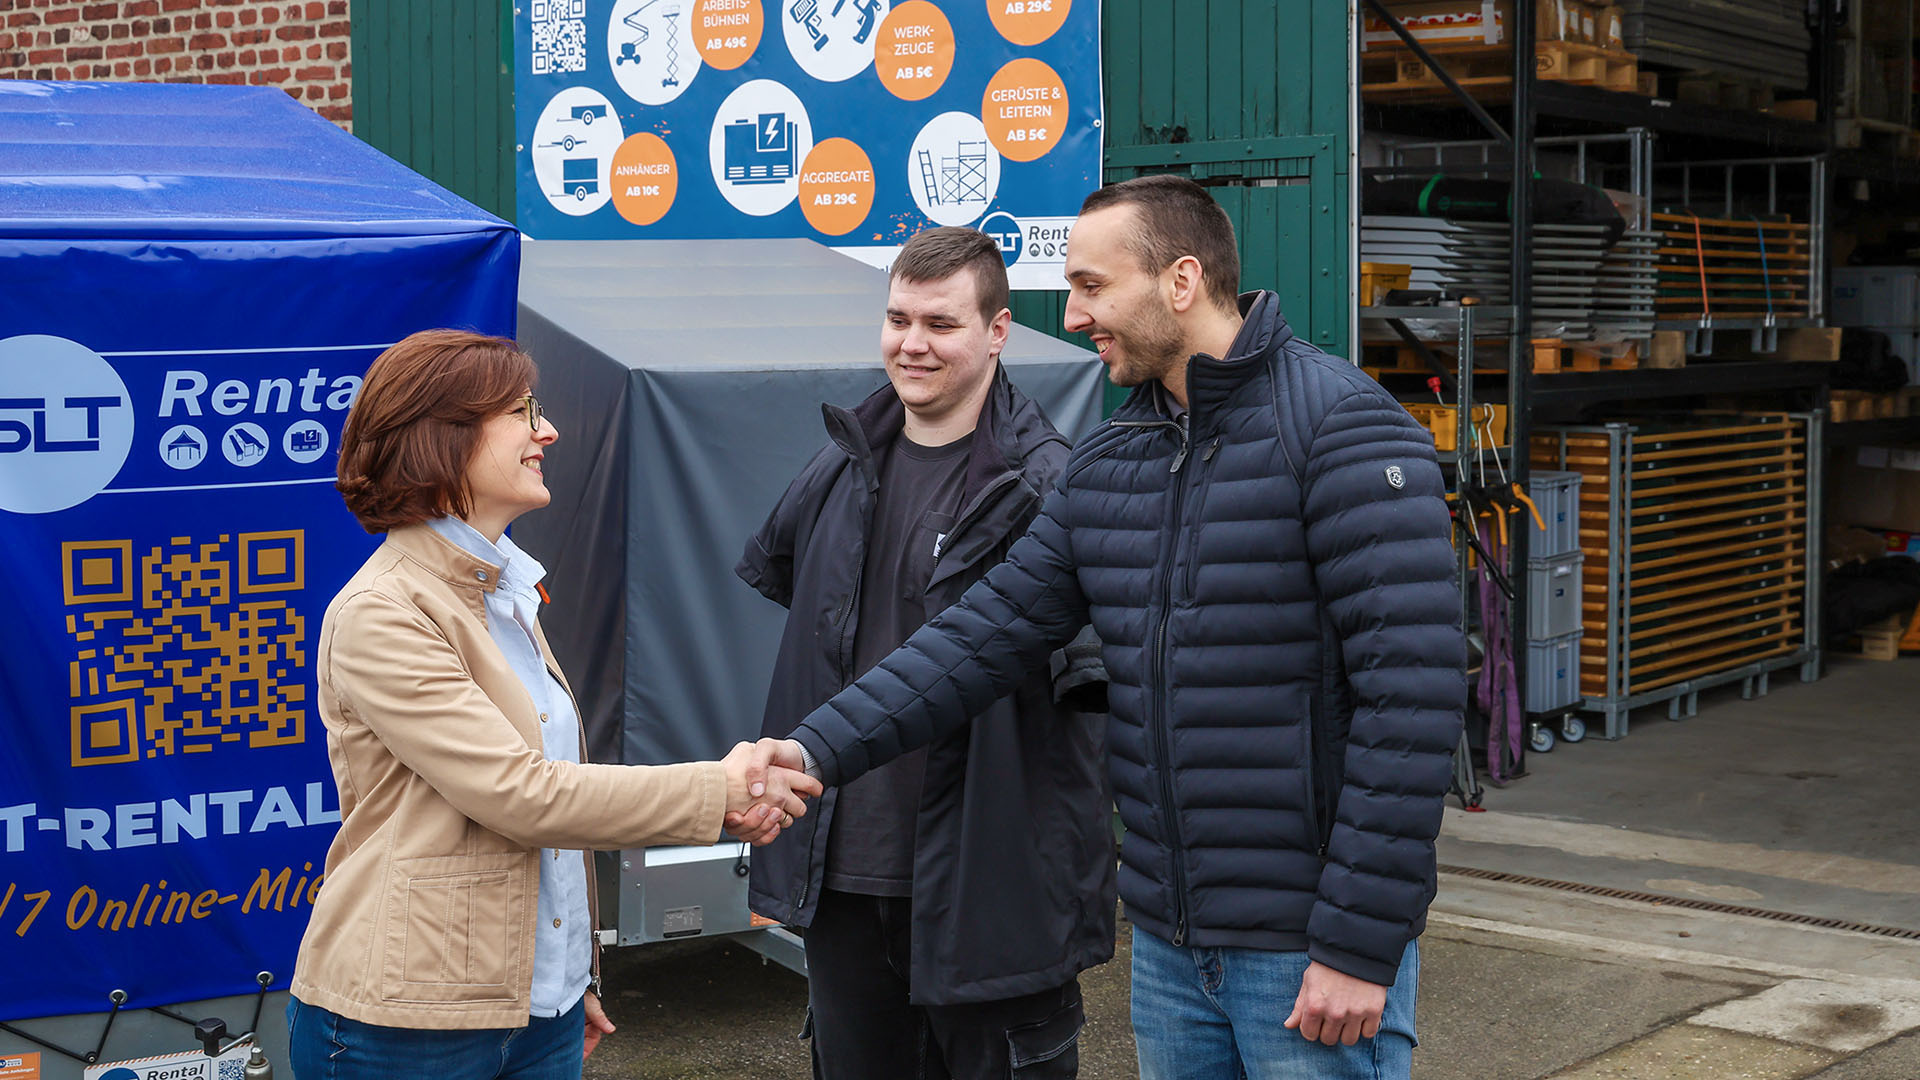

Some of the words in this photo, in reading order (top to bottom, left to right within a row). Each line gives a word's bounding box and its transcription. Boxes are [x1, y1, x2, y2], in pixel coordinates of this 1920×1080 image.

[702, 0, 750, 12] ARBEITS-
[1005, 2, 1025, 14] AB
[1027, 0, 1052, 12] 29€
[703, 13, 750, 28] BÜHNEN
[894, 25, 935, 38] WERK-
[706, 38, 723, 50] AB
[724, 36, 748, 48] 49€
[894, 41, 935, 56] ZEUGE
[896, 67, 914, 79] AB
[916, 66, 934, 78] 5€
[992, 86, 1049, 102] GERÜSTE
[1051, 87, 1062, 99] &
[1000, 105, 1052, 119] LEITERN
[1006, 129, 1026, 142] AB
[1029, 128, 1047, 141] 5€
[615, 162, 670, 176] ANHÄNGER
[802, 170, 870, 184] AGGREGATE
[625, 186, 641, 197] AB
[642, 185, 660, 196] 10€
[814, 194, 832, 206] AB
[834, 193, 857, 205] 29€
[158, 368, 363, 417] Renta
[0, 782, 342, 852] T-RENTAL
[147, 1063, 204, 1080] Rental
